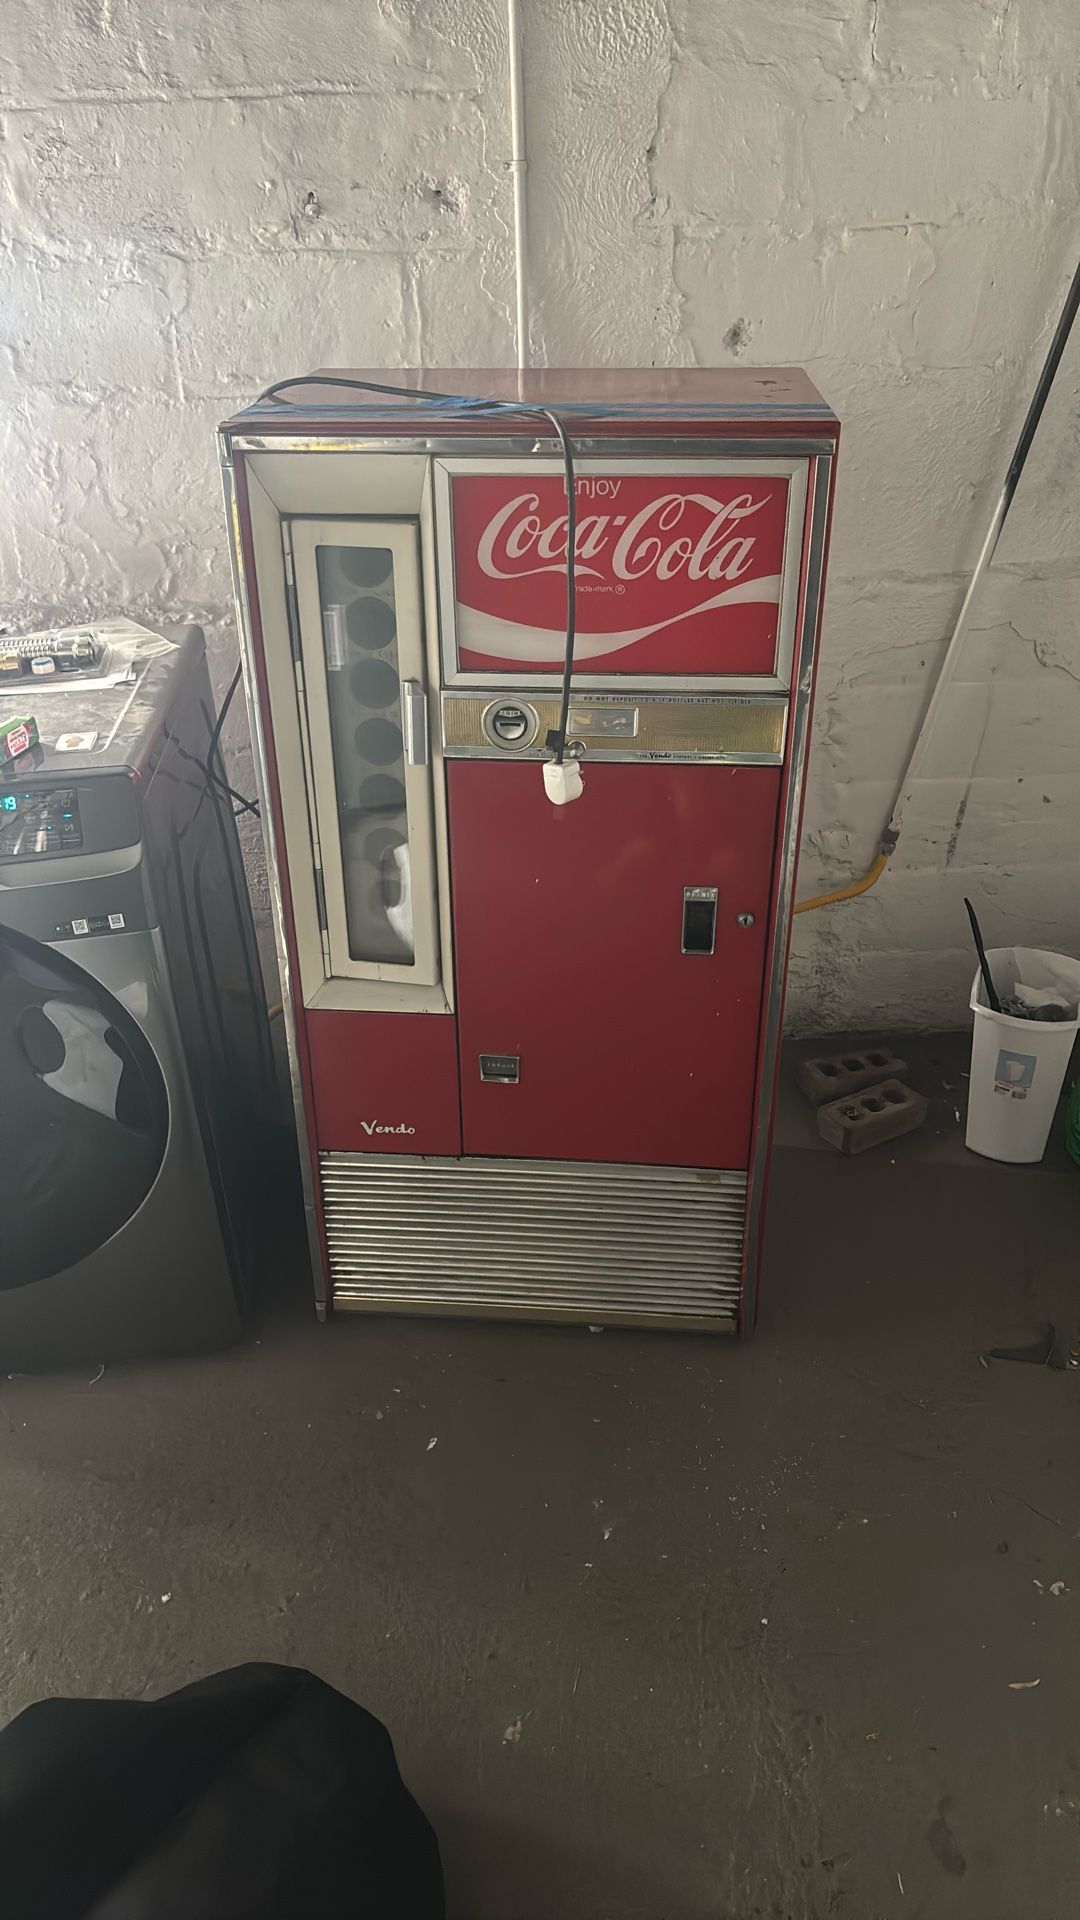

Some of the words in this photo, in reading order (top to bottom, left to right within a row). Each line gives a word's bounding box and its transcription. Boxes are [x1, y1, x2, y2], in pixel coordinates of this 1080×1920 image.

[478, 494, 772, 580] Coca-Cola
[649, 752, 672, 760] Vendo
[361, 1120, 416, 1135] Vendo
